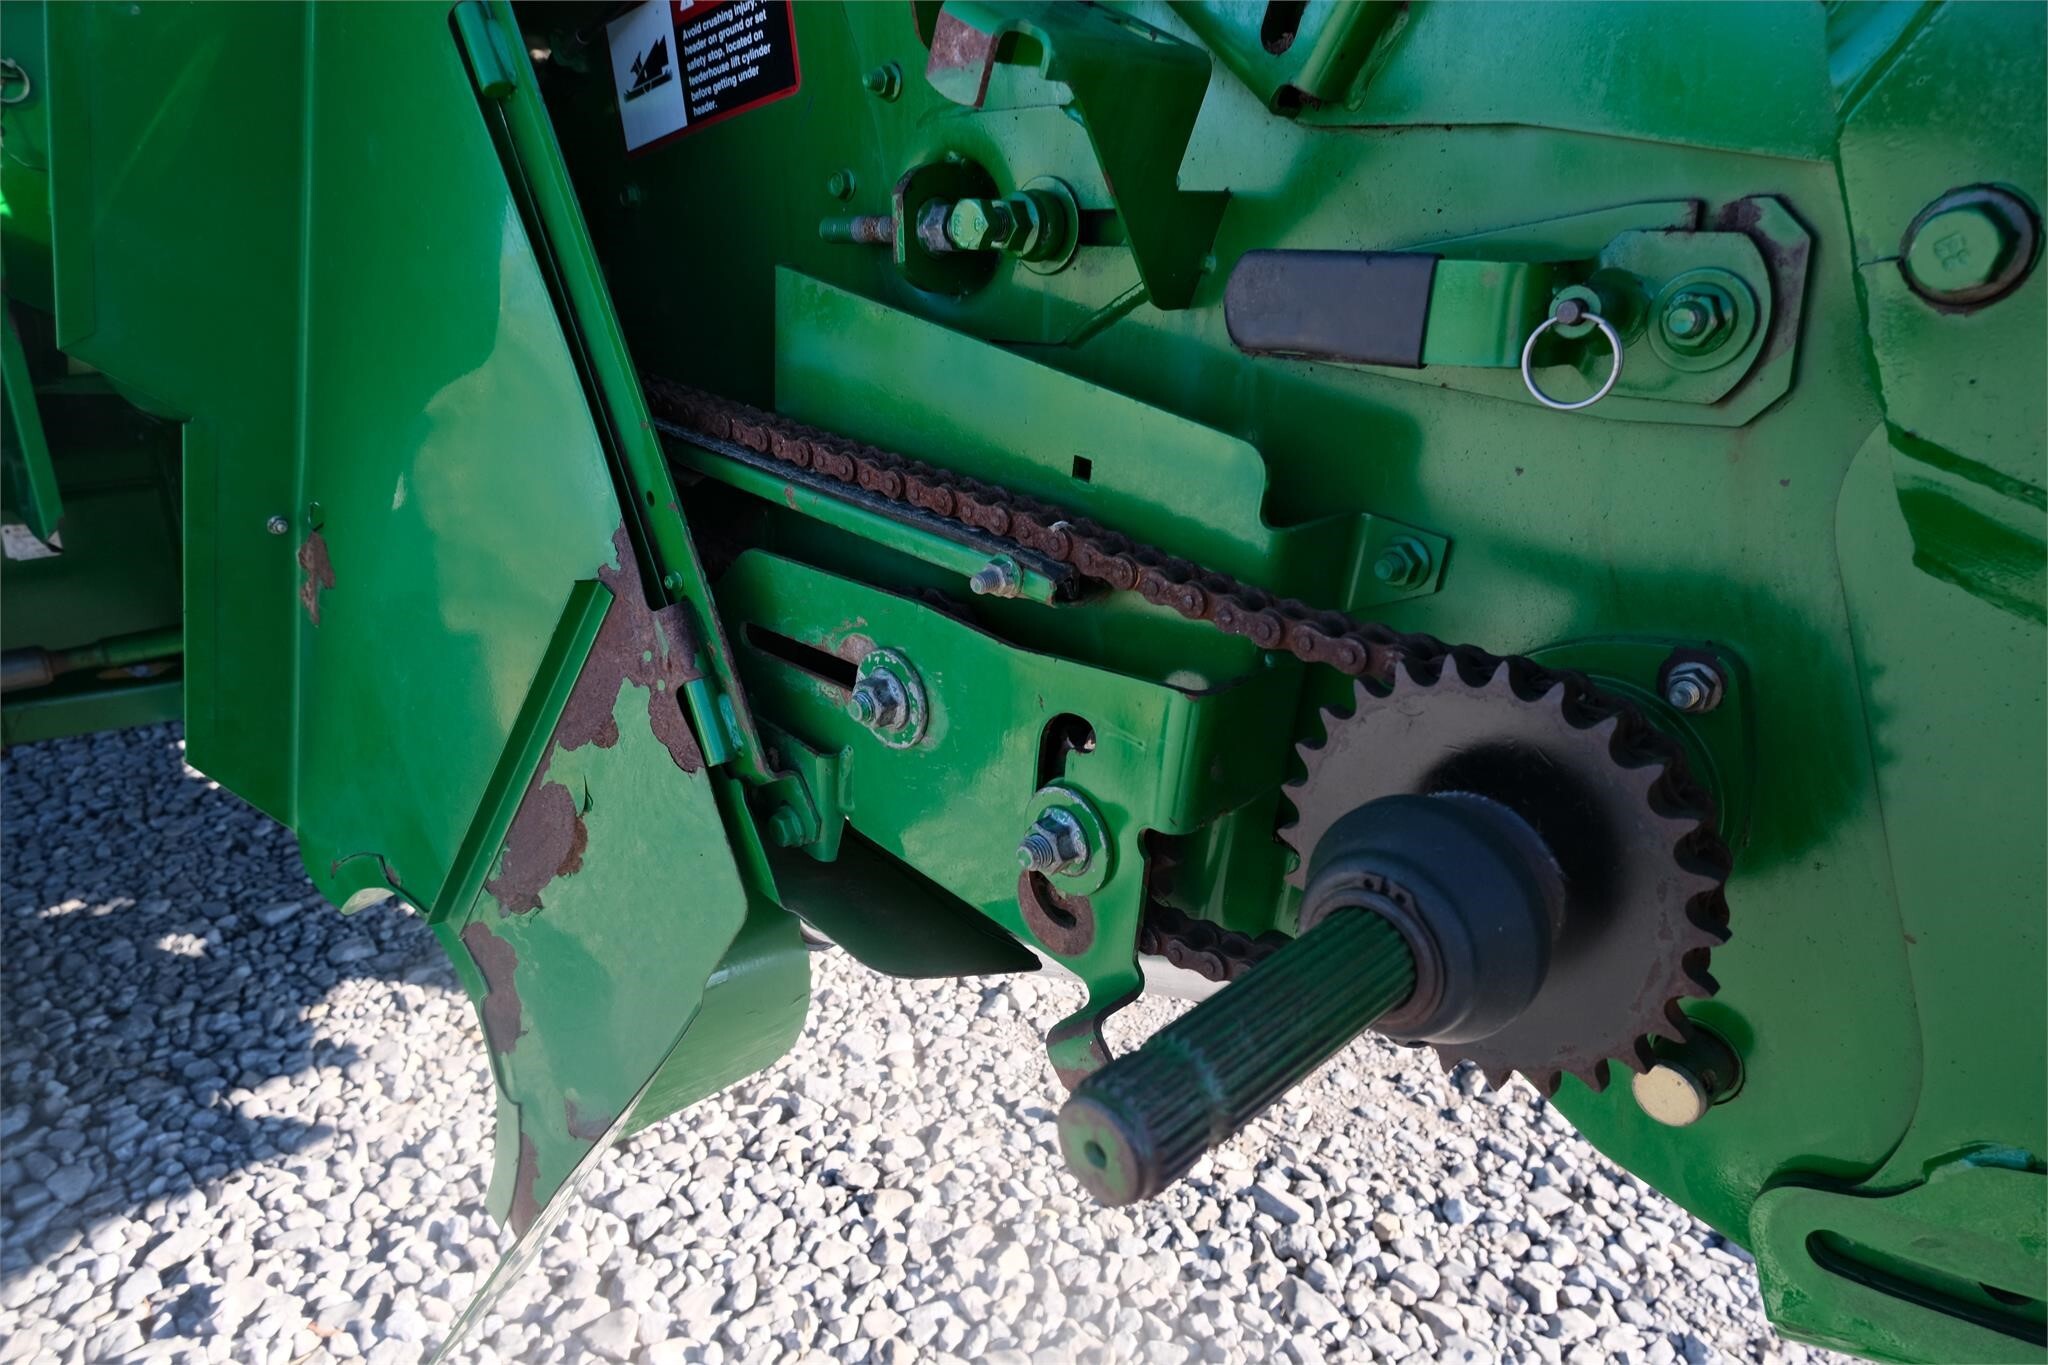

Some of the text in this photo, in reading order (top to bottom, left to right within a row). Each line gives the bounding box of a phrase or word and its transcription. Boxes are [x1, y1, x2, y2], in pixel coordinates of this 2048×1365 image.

[683, 0, 758, 40] Avoid crushing injury.
[684, 9, 767, 56] header on ground or set
[686, 30, 764, 72] safety stop, located on
[688, 43, 771, 86] feederhouse lift cylinder
[690, 65, 760, 102] before getting under
[692, 100, 718, 117] header.
